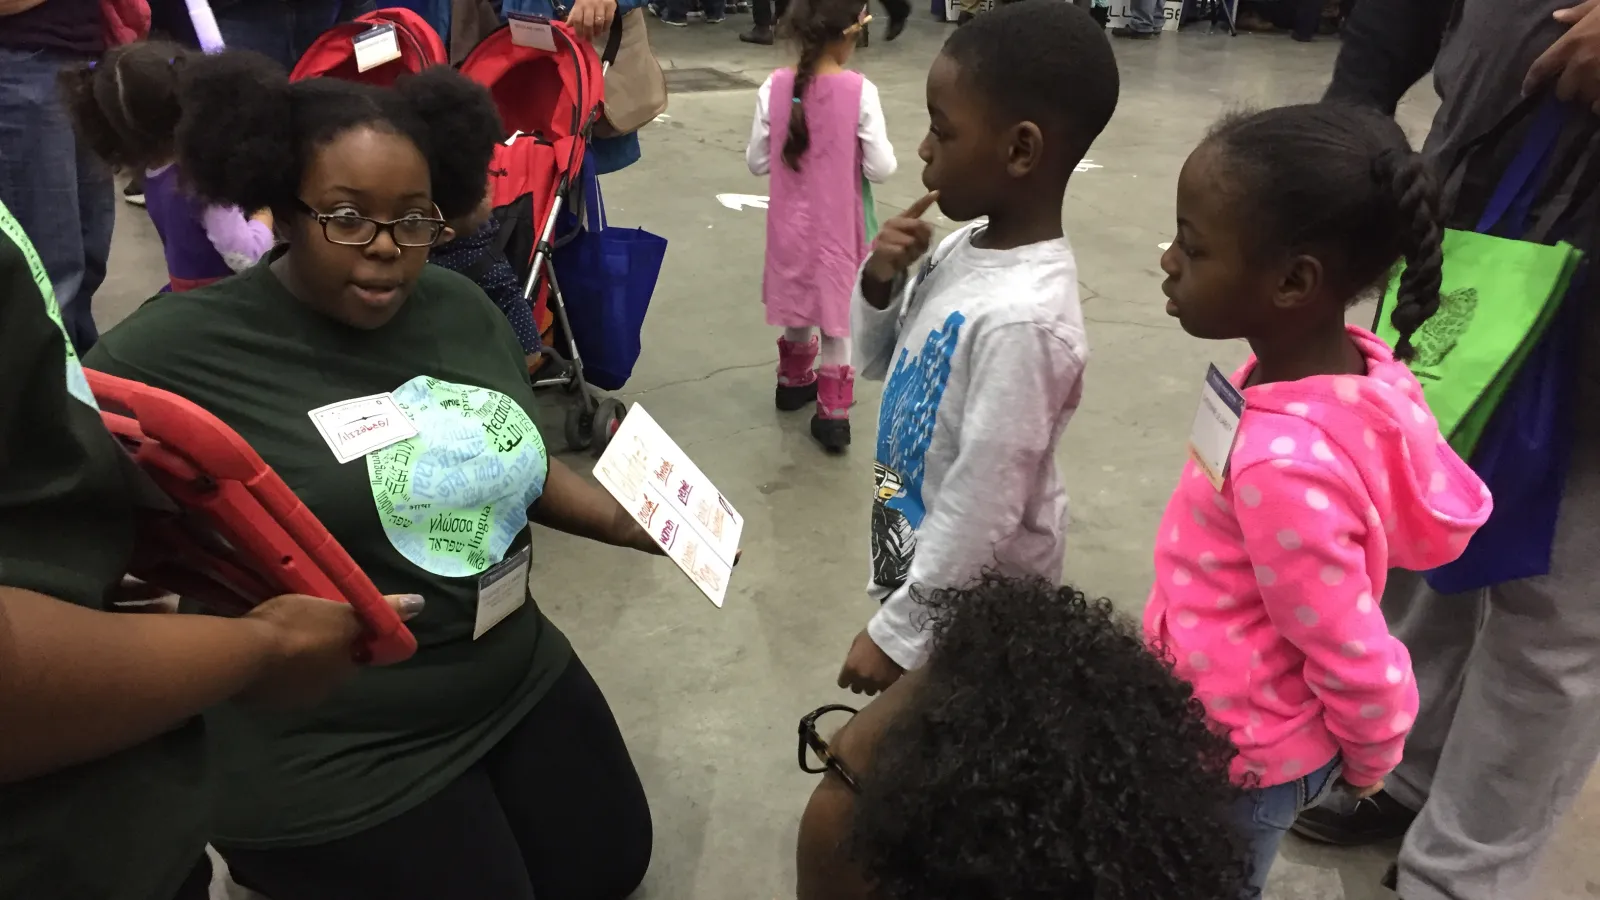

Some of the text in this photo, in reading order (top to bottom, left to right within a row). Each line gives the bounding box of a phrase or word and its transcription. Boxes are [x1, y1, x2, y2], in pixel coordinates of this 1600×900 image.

[429, 512, 474, 534] γλώσσα
[659, 518, 674, 546] women
[467, 550, 486, 570] wika
